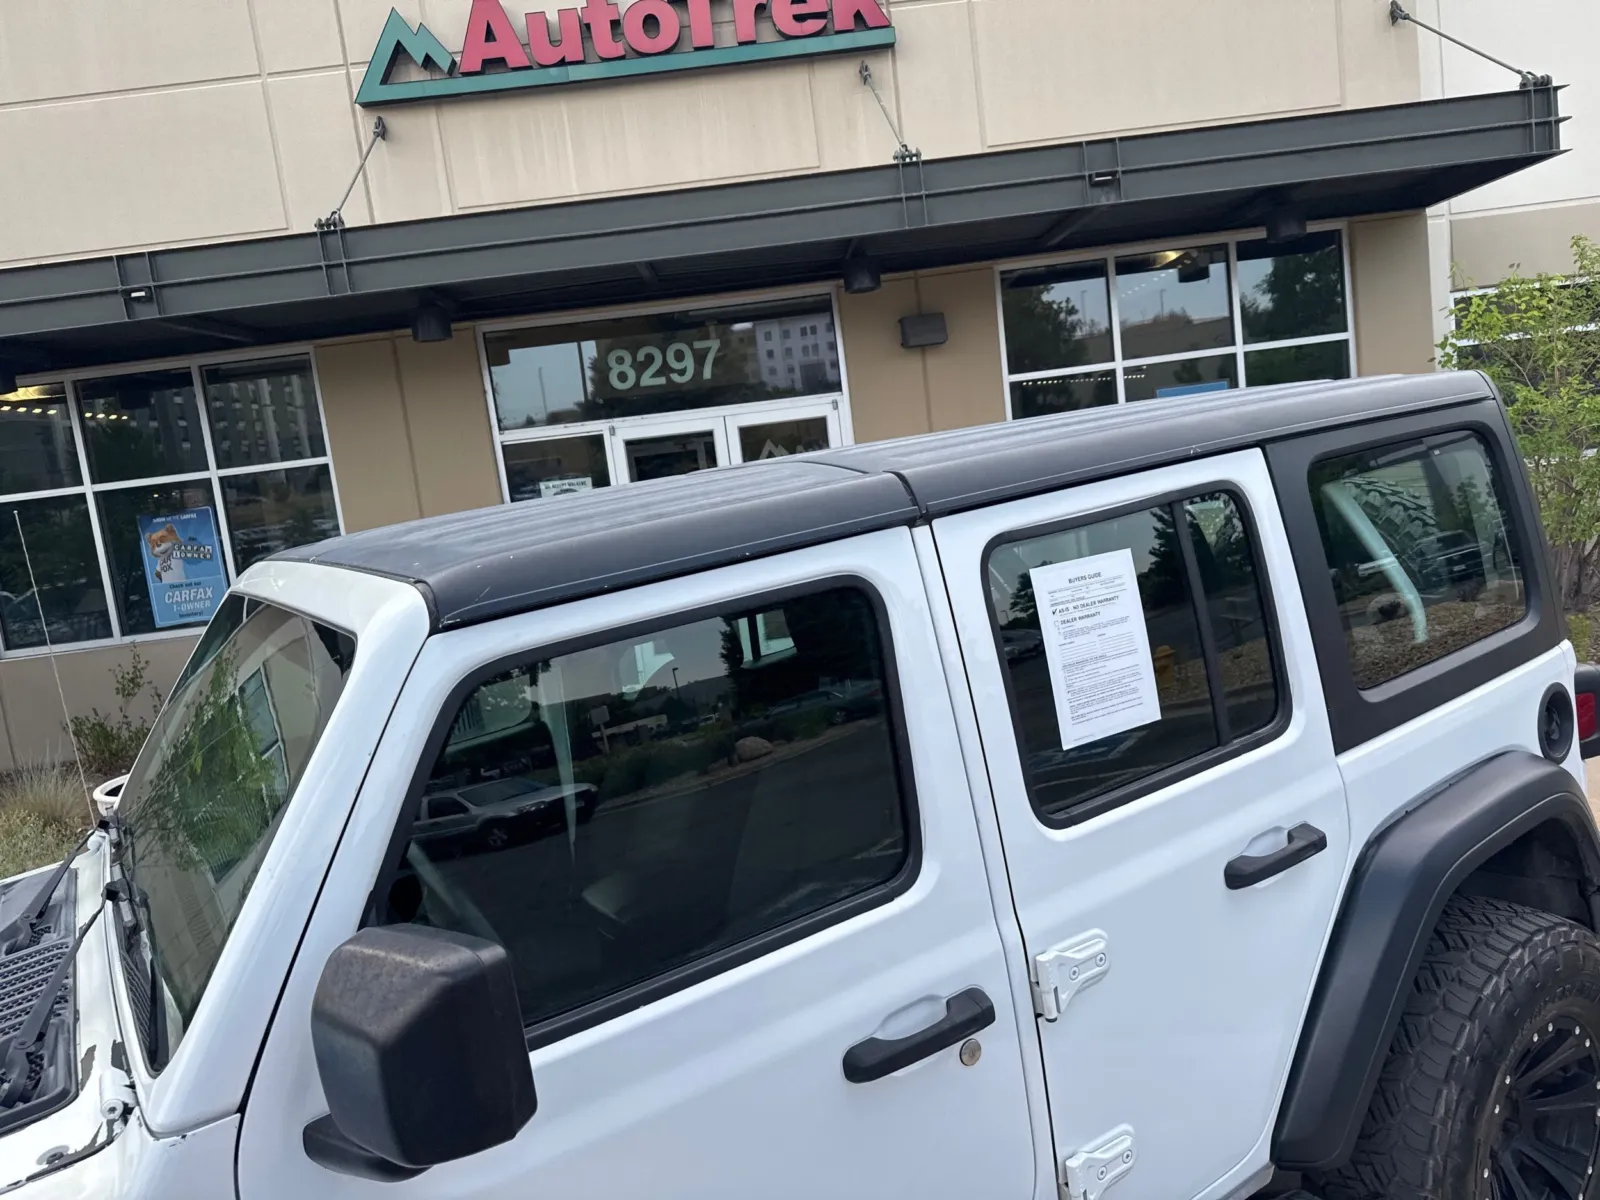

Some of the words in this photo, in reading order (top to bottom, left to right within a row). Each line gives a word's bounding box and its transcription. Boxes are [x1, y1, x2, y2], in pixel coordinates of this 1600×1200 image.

[607, 340, 720, 390] 8297
[181, 552, 211, 560] OWNER
[1068, 575, 1087, 584] BUYERS
[1088, 572, 1101, 580] GUIDE
[165, 587, 213, 604] CARFAX
[1080, 600, 1097, 609] DEALER
[1097, 595, 1119, 604] WARRANTY
[173, 600, 211, 612] 1-OWNER
[1060, 616, 1078, 625] DEALER
[1078, 611, 1100, 621] WARRANTY
